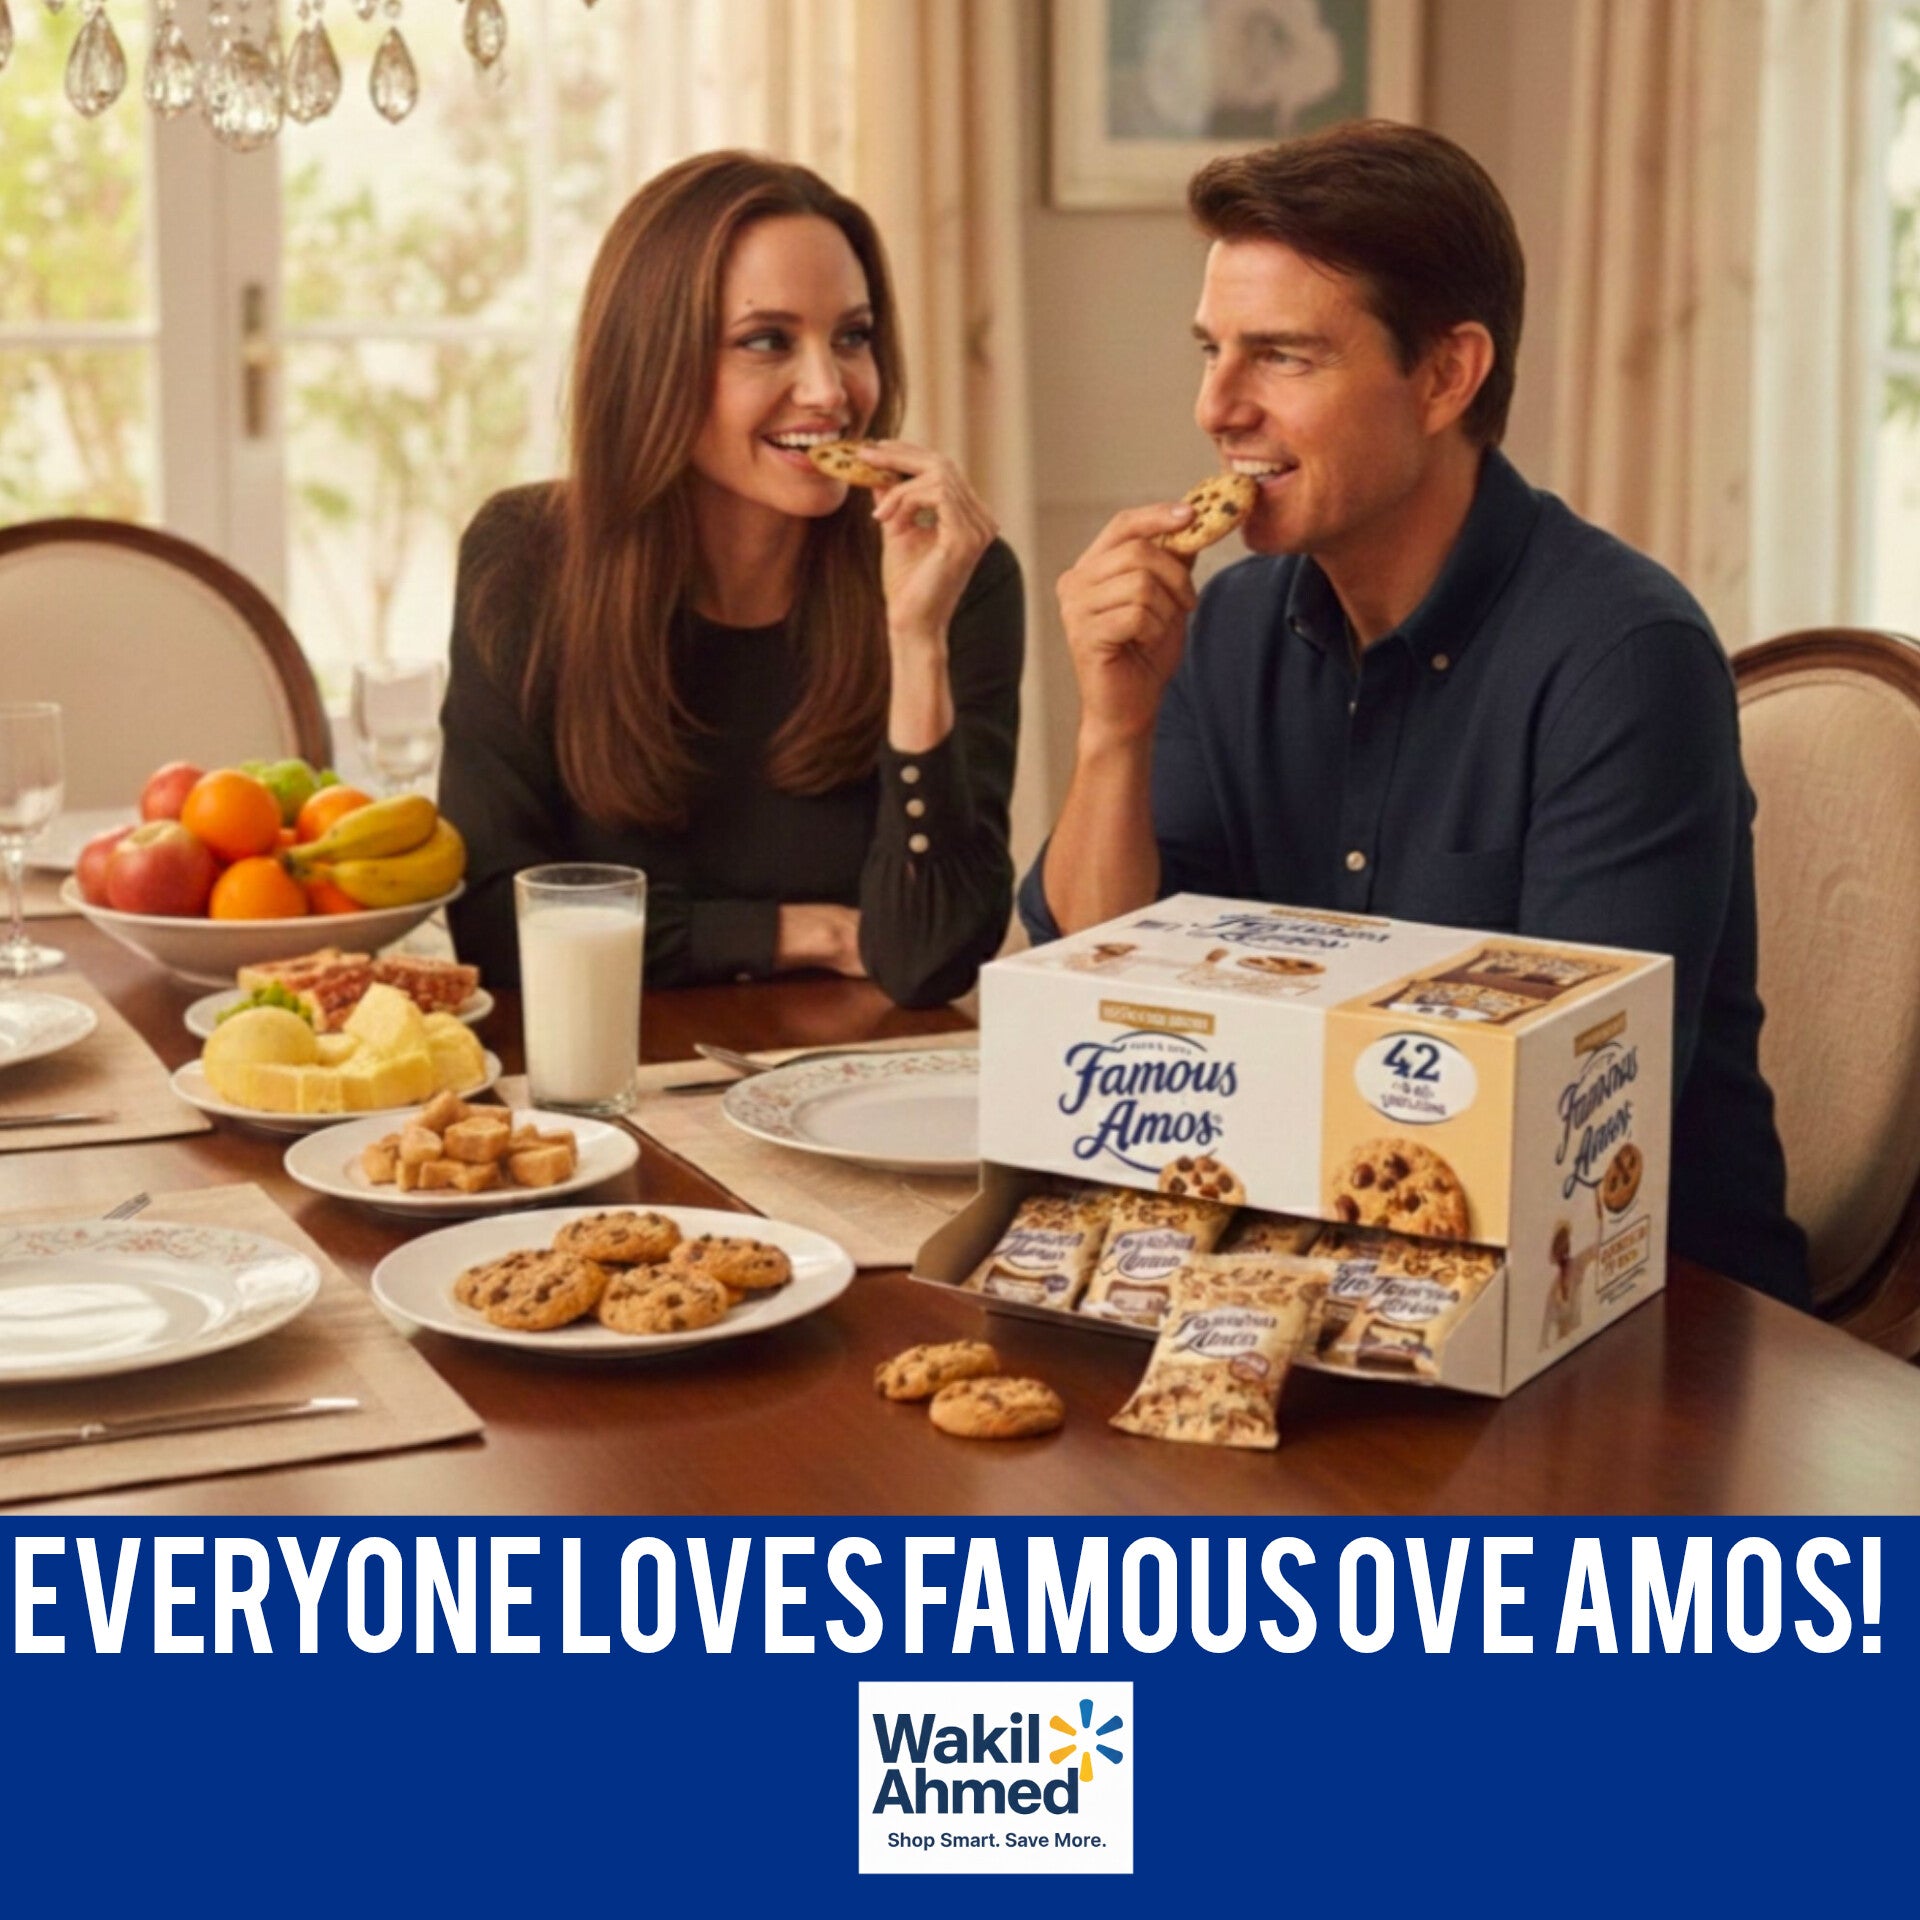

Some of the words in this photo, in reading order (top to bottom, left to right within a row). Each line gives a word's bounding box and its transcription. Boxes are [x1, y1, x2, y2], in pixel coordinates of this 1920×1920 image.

[1058, 1042, 1238, 1116] Famous
[1382, 1038, 1441, 1083] 42
[1073, 1098, 1223, 1161] Amos
